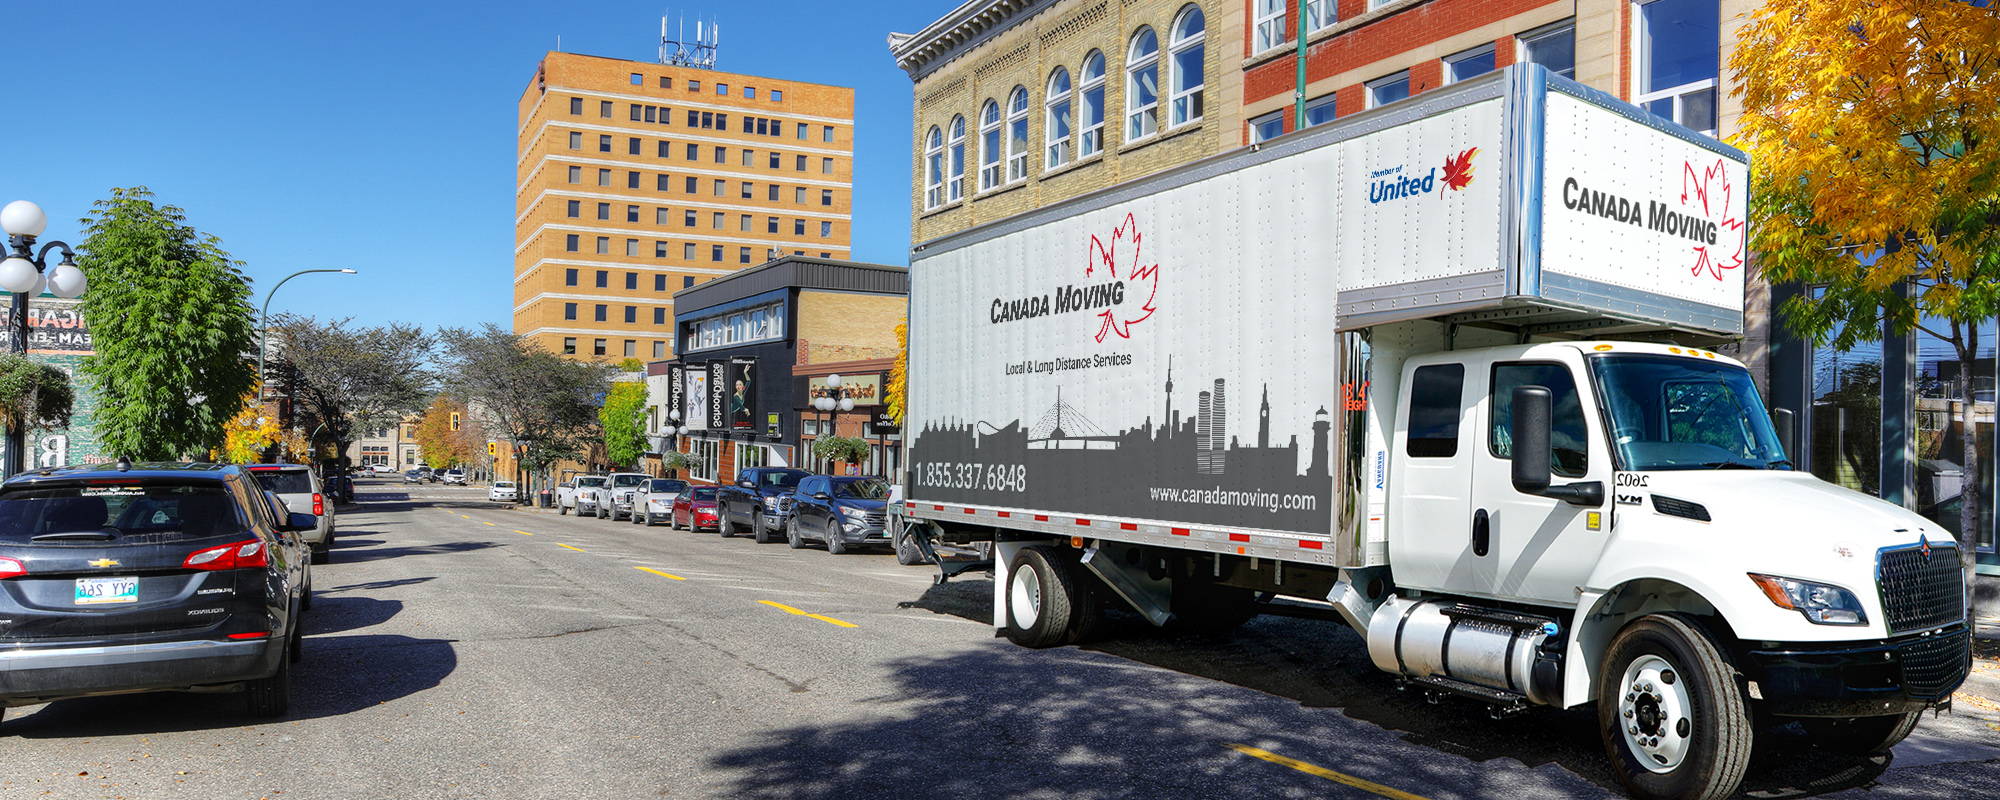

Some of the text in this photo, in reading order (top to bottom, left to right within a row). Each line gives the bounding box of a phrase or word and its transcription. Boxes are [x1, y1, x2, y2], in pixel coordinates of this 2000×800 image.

[1369, 167, 1436, 204] United
[1370, 164, 1403, 179] Member of
[1563, 176, 1718, 245] CANADA MOVING
[990, 281, 1125, 324] CANADA MOVING
[1005, 352, 1132, 376] Local & Long Distance Services
[1343, 399, 1368, 411] HEIGHT
[915, 461, 1027, 493] 1.855.337.6848
[1150, 485, 1316, 513] www.canadamoving.com
